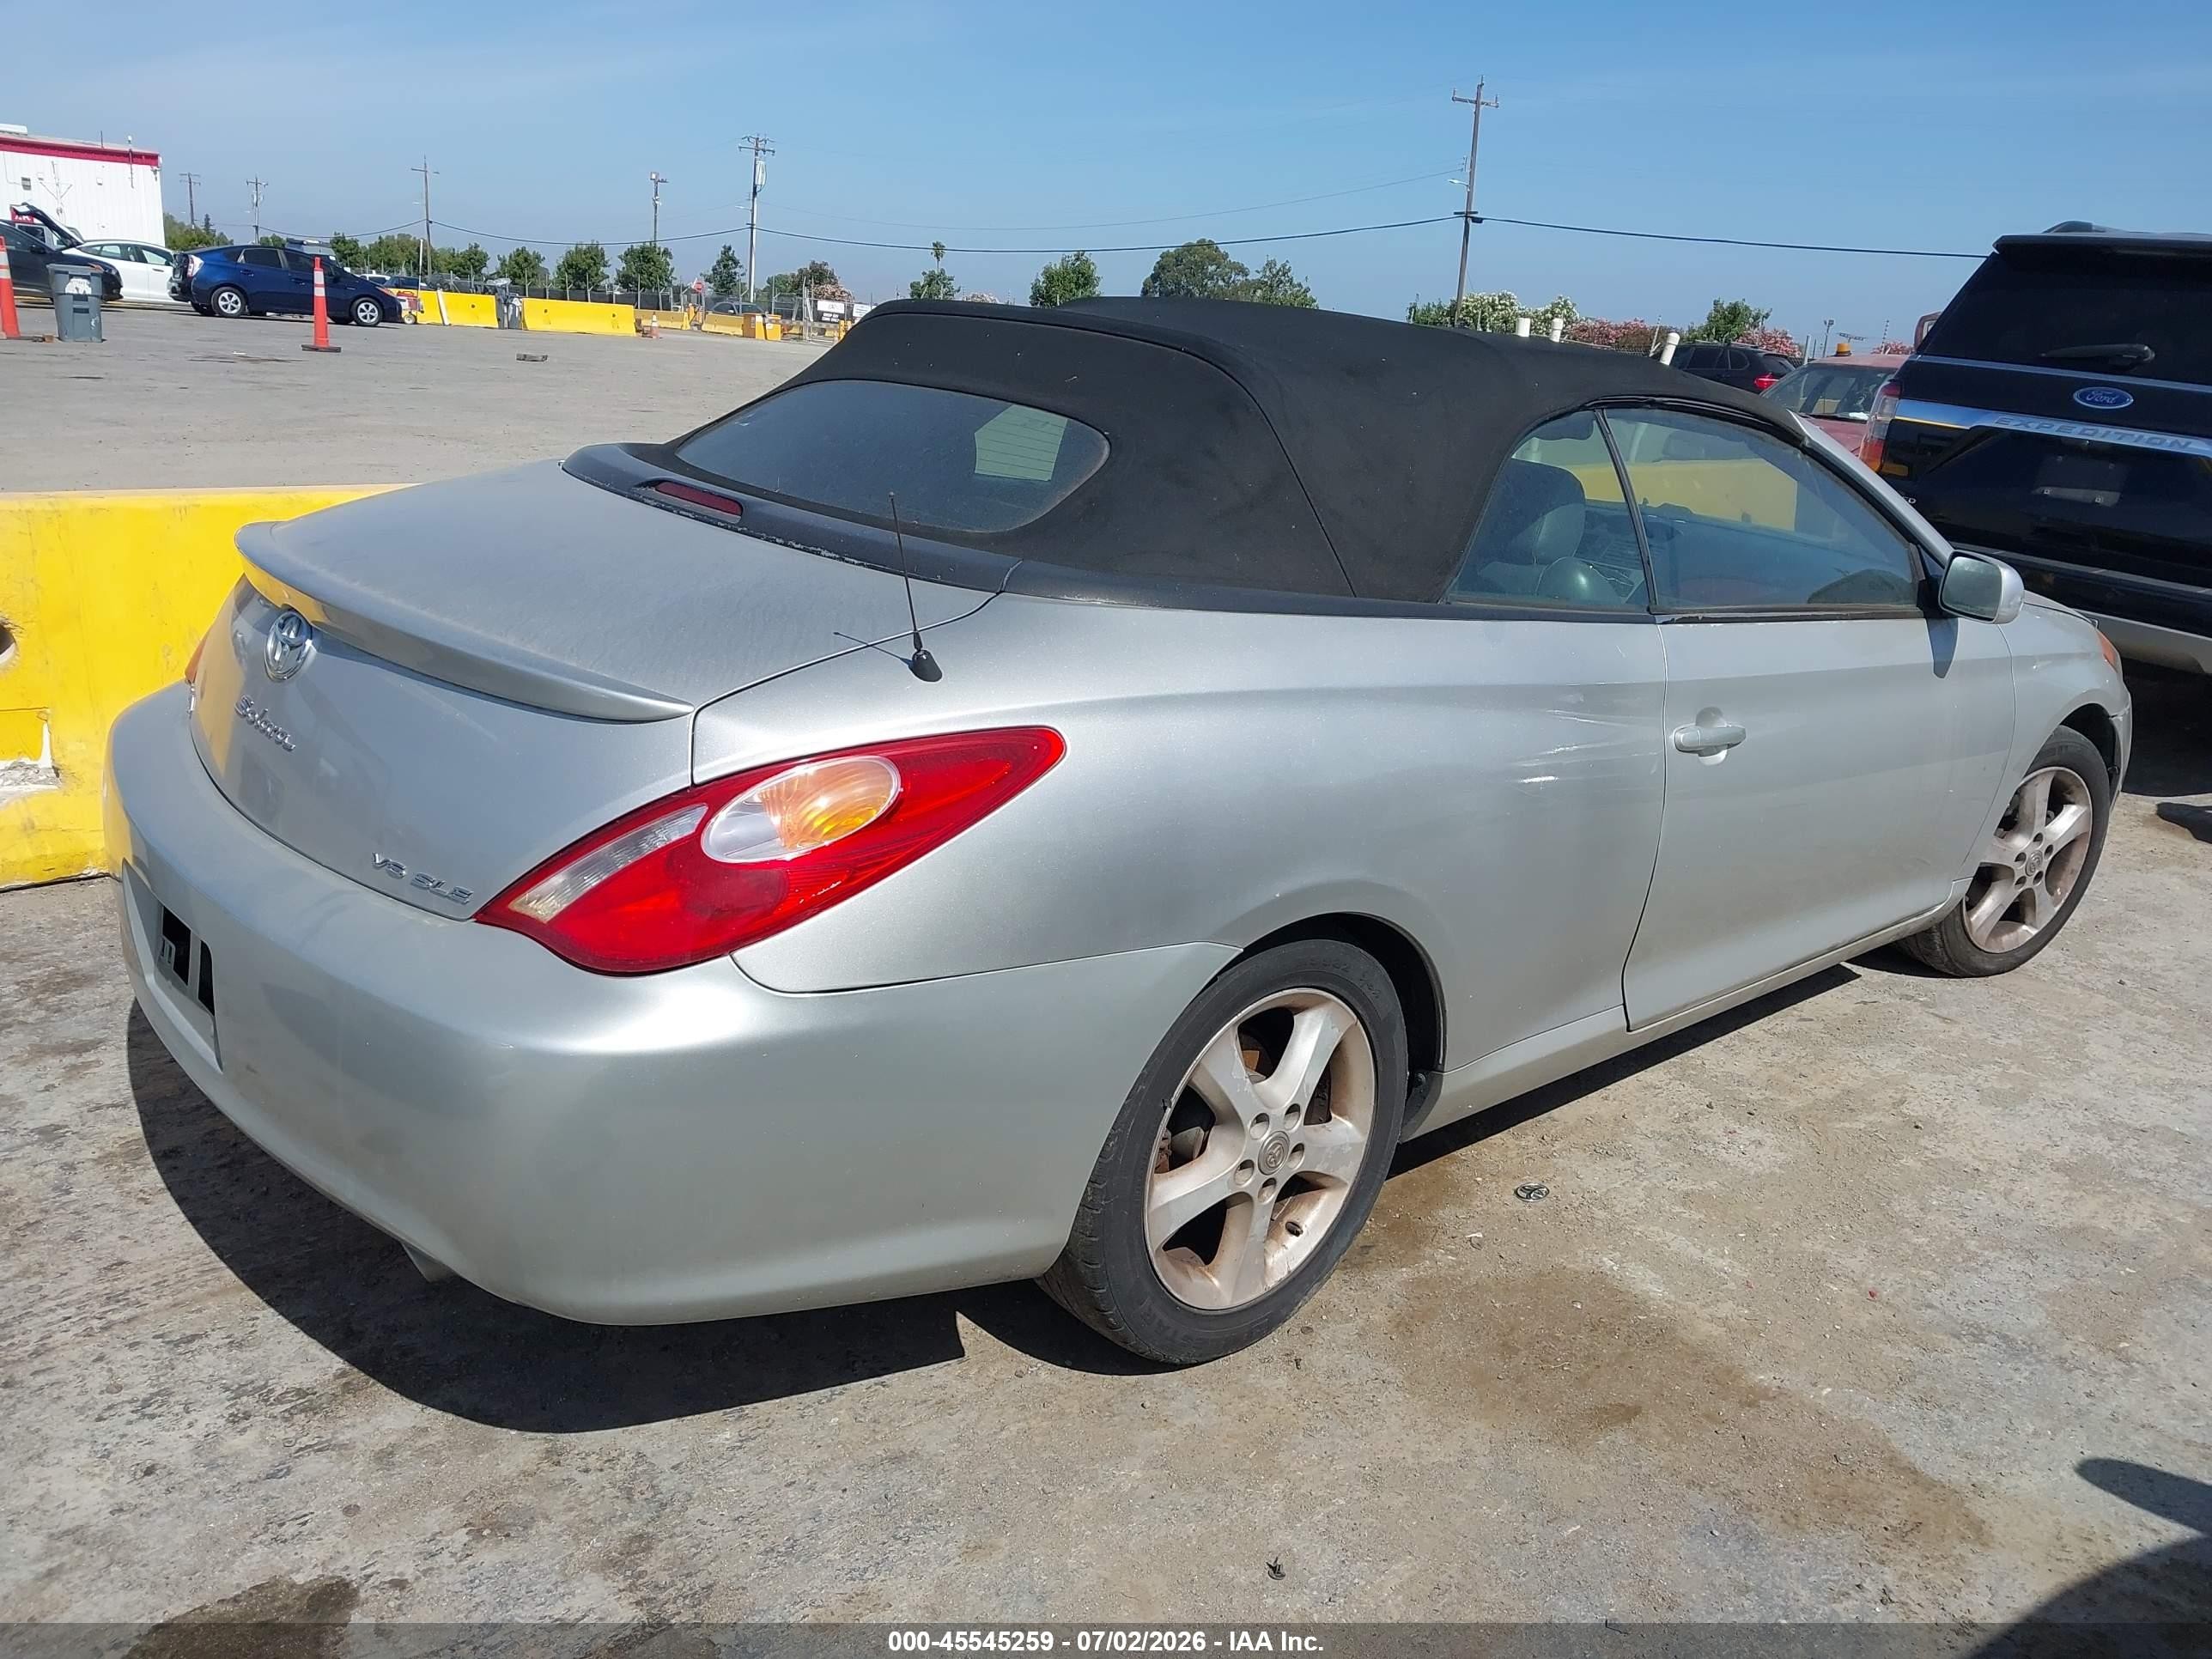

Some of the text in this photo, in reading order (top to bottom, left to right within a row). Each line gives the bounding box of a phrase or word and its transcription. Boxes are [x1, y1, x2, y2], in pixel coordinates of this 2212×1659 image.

[2085, 390, 2118, 404] Ford
[1994, 416, 2192, 449] EXPEDITION
[234, 695, 296, 750] Solara
[372, 852, 475, 905] V6 SLE
